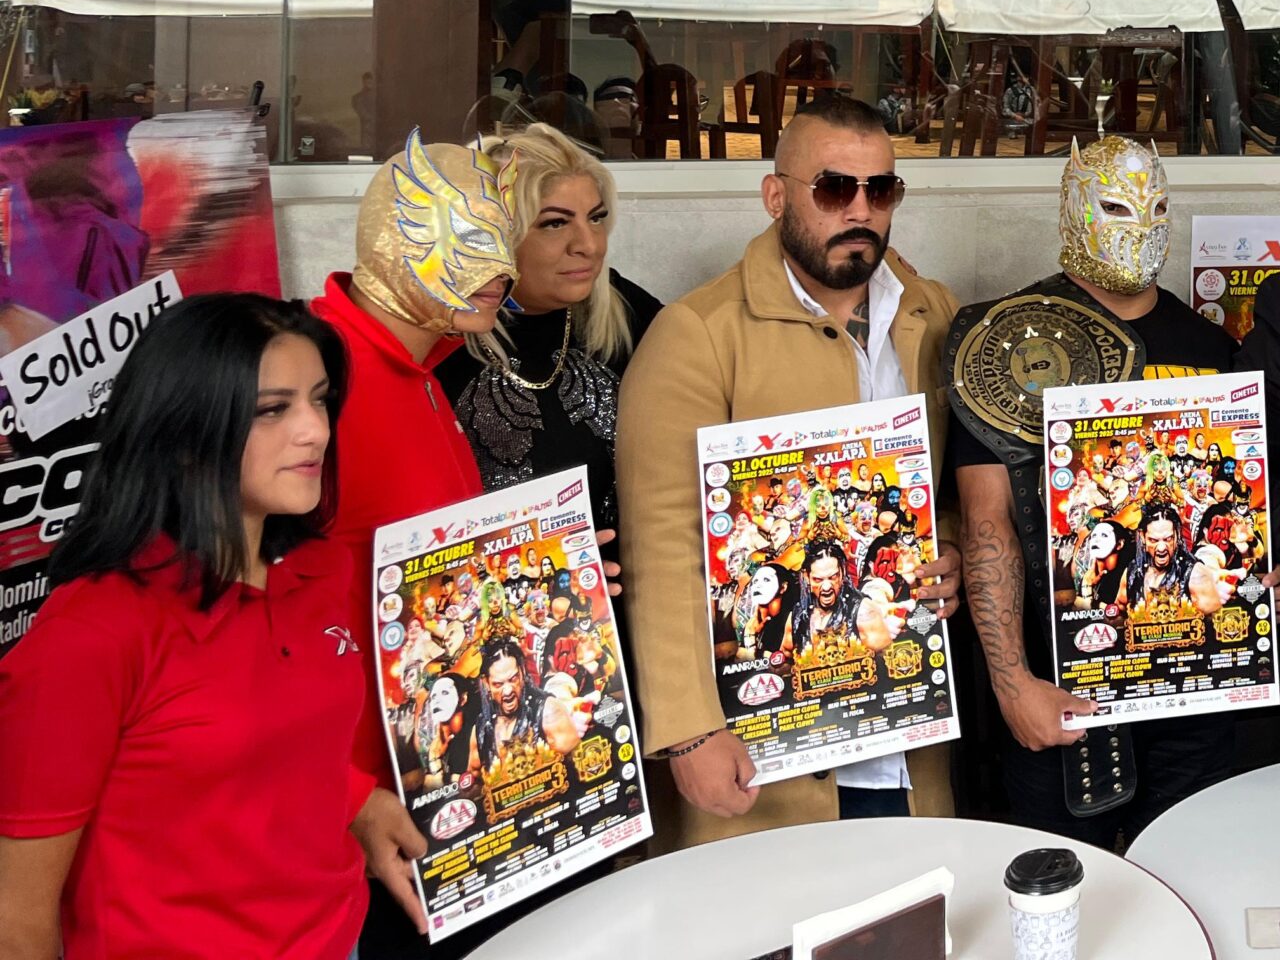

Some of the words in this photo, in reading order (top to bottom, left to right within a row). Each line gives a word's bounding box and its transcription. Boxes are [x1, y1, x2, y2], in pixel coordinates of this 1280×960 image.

[1229, 269, 1248, 286] 31
[20, 317, 105, 405] Sold
[109, 281, 170, 352] Out
[1150, 395, 1187, 408] Totalplay
[1232, 385, 1257, 399] CINETIX
[1074, 420, 1088, 431] 31
[1093, 415, 1143, 430] OCTUBRE
[1179, 410, 1199, 418] ARENA
[1221, 412, 1259, 421] EXPRESS
[810, 426, 849, 442] Totalplay
[894, 410, 920, 426] CINETIX
[1152, 416, 1203, 432] XALAPA
[884, 433, 912, 442] Cemento
[884, 437, 923, 450] EXPRESS
[1074, 431, 1098, 439] VIERNES
[1099, 429, 1113, 437] 2025
[841, 440, 862, 450] ARENA
[731, 459, 747, 473] 31
[751, 450, 804, 470] OCTUBRE
[814, 446, 866, 466] XALAPA
[732, 470, 757, 481] VIERNES
[758, 467, 773, 476] 2025
[481, 507, 517, 530] Totalplay
[557, 483, 582, 503] CINETIX
[550, 511, 586, 530] EXPRESS
[484, 528, 534, 557] XALAPA
[404, 557, 419, 575] 31
[424, 540, 474, 569] OCTUBRE
[1061, 608, 1104, 621] AVANRADIO
[1077, 623, 1112, 644] AAA
[1134, 621, 1190, 636] TERRITORIO
[1190, 618, 1202, 640] 3
[722, 657, 769, 675] AVANRADIO
[801, 660, 860, 683] TERRITORIO
[859, 656, 874, 681] 3
[741, 671, 778, 698] AAA
[801, 703, 820, 713] CLOWN
[803, 710, 822, 719] CLOWN
[795, 719, 814, 728] CLOWN
[492, 767, 551, 804] TERRITORIO
[549, 760, 565, 790] 3
[411, 780, 459, 810] AVANRADIO
[432, 796, 471, 833] AAA
